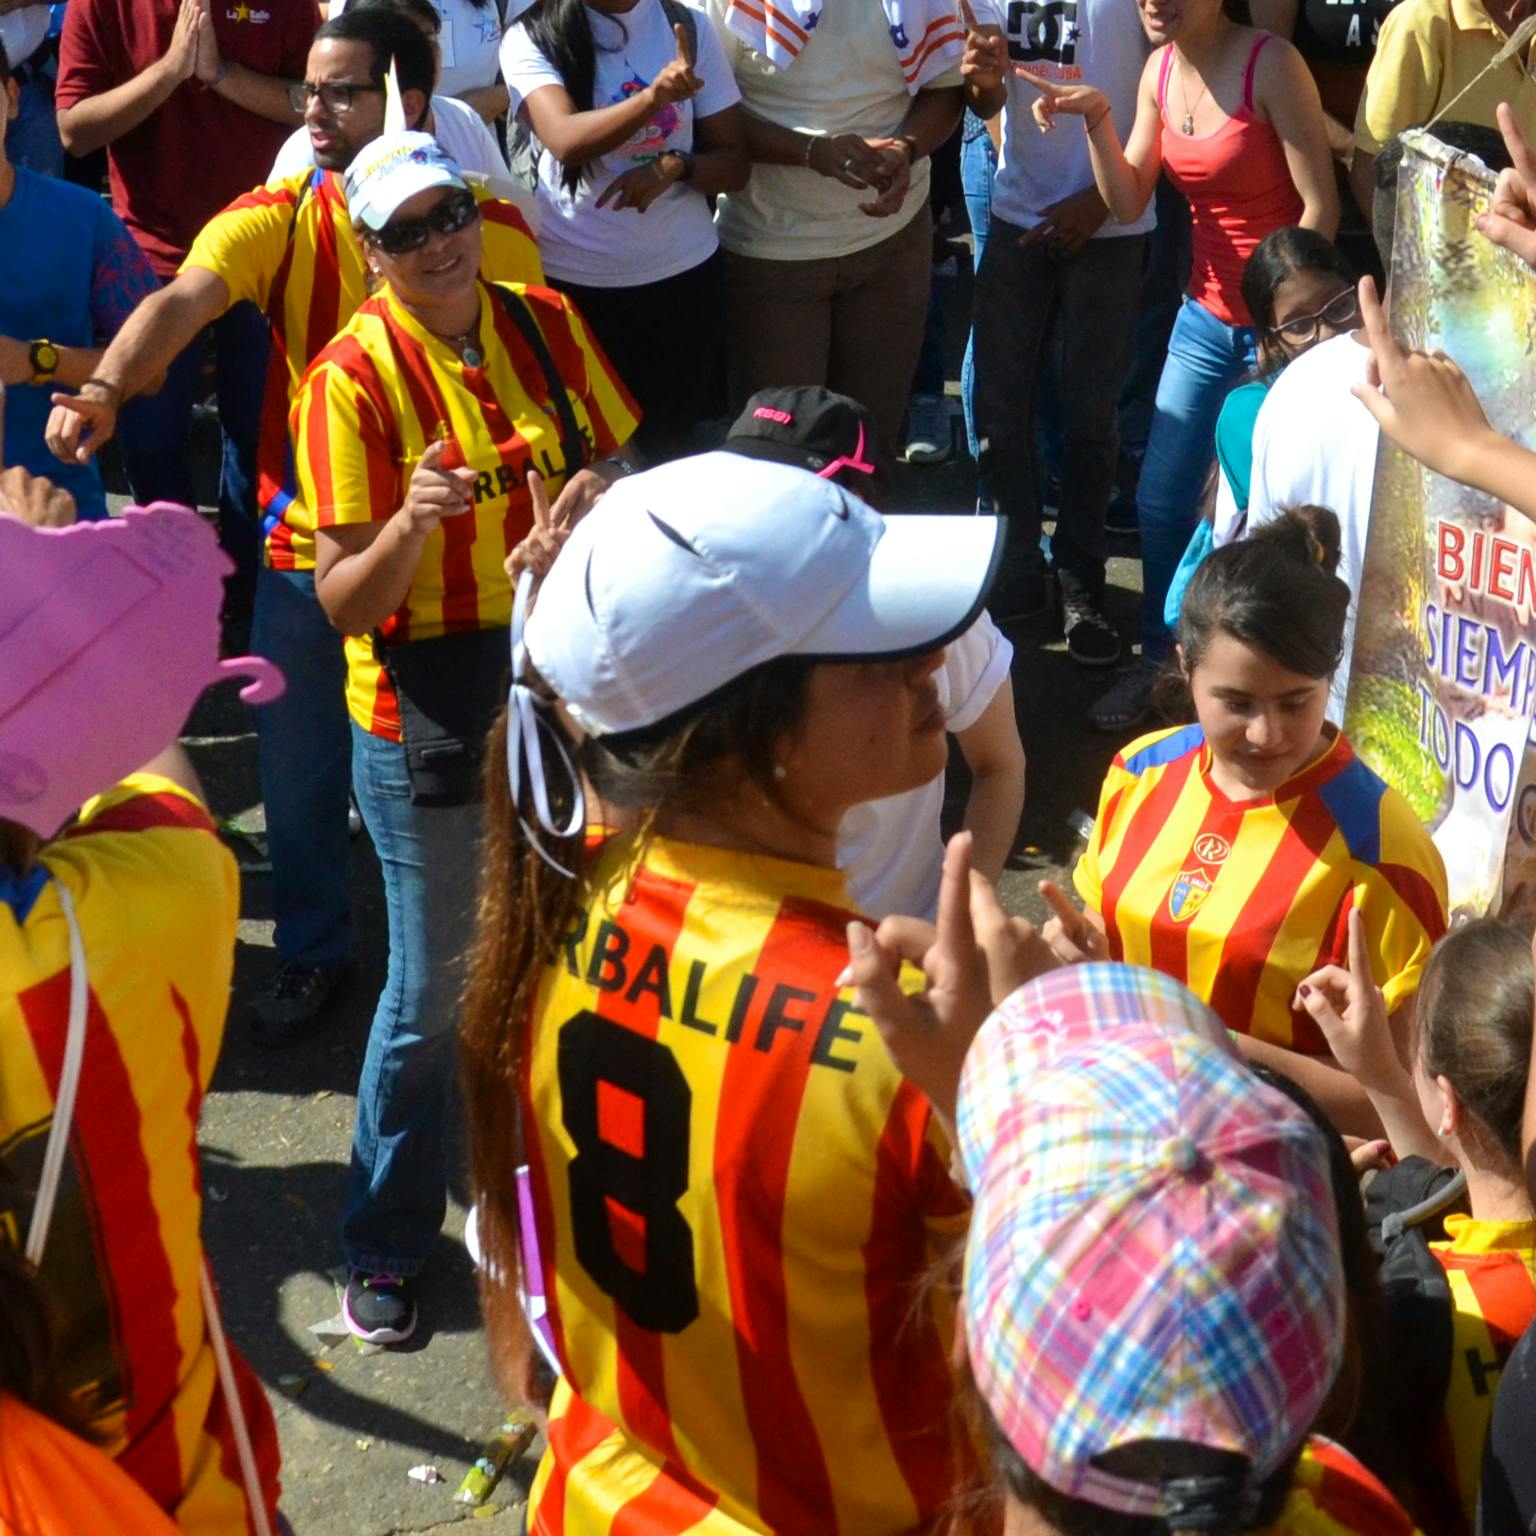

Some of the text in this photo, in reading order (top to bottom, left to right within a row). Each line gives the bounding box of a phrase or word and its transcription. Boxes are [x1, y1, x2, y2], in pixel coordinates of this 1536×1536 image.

[1345, 13, 1362, 47] A
[562, 906, 868, 1075] RBALIFE
[557, 1008, 701, 1335] 8
